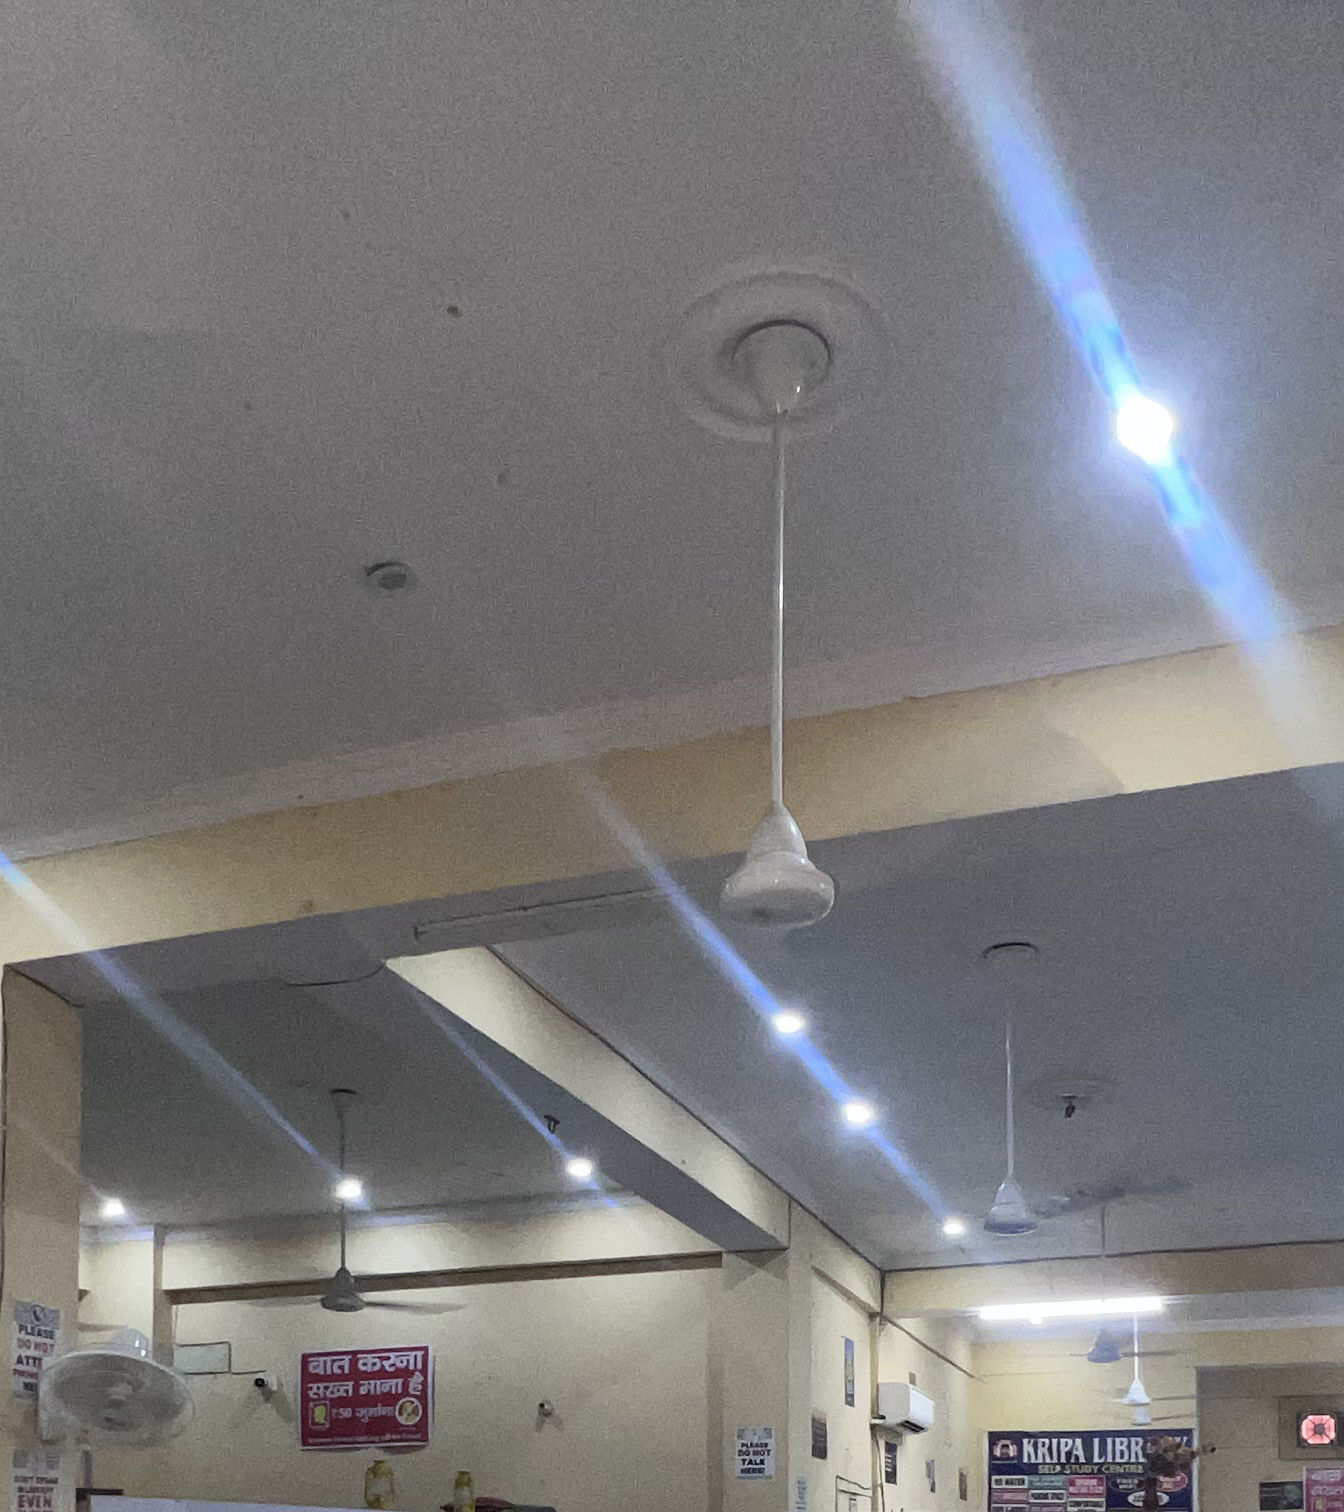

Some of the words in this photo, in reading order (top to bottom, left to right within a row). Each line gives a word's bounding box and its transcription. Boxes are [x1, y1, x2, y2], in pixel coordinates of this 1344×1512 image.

[307, 1355, 352, 1375] बात
[357, 1350, 425, 1372] करना
[408, 1370, 425, 1396] है
[741, 1458, 766, 1466] TALK
[1022, 1438, 1087, 1464] KRIPA
[1093, 1437, 1188, 1463] LIBR
[1064, 1465, 1099, 1474] STUDY
